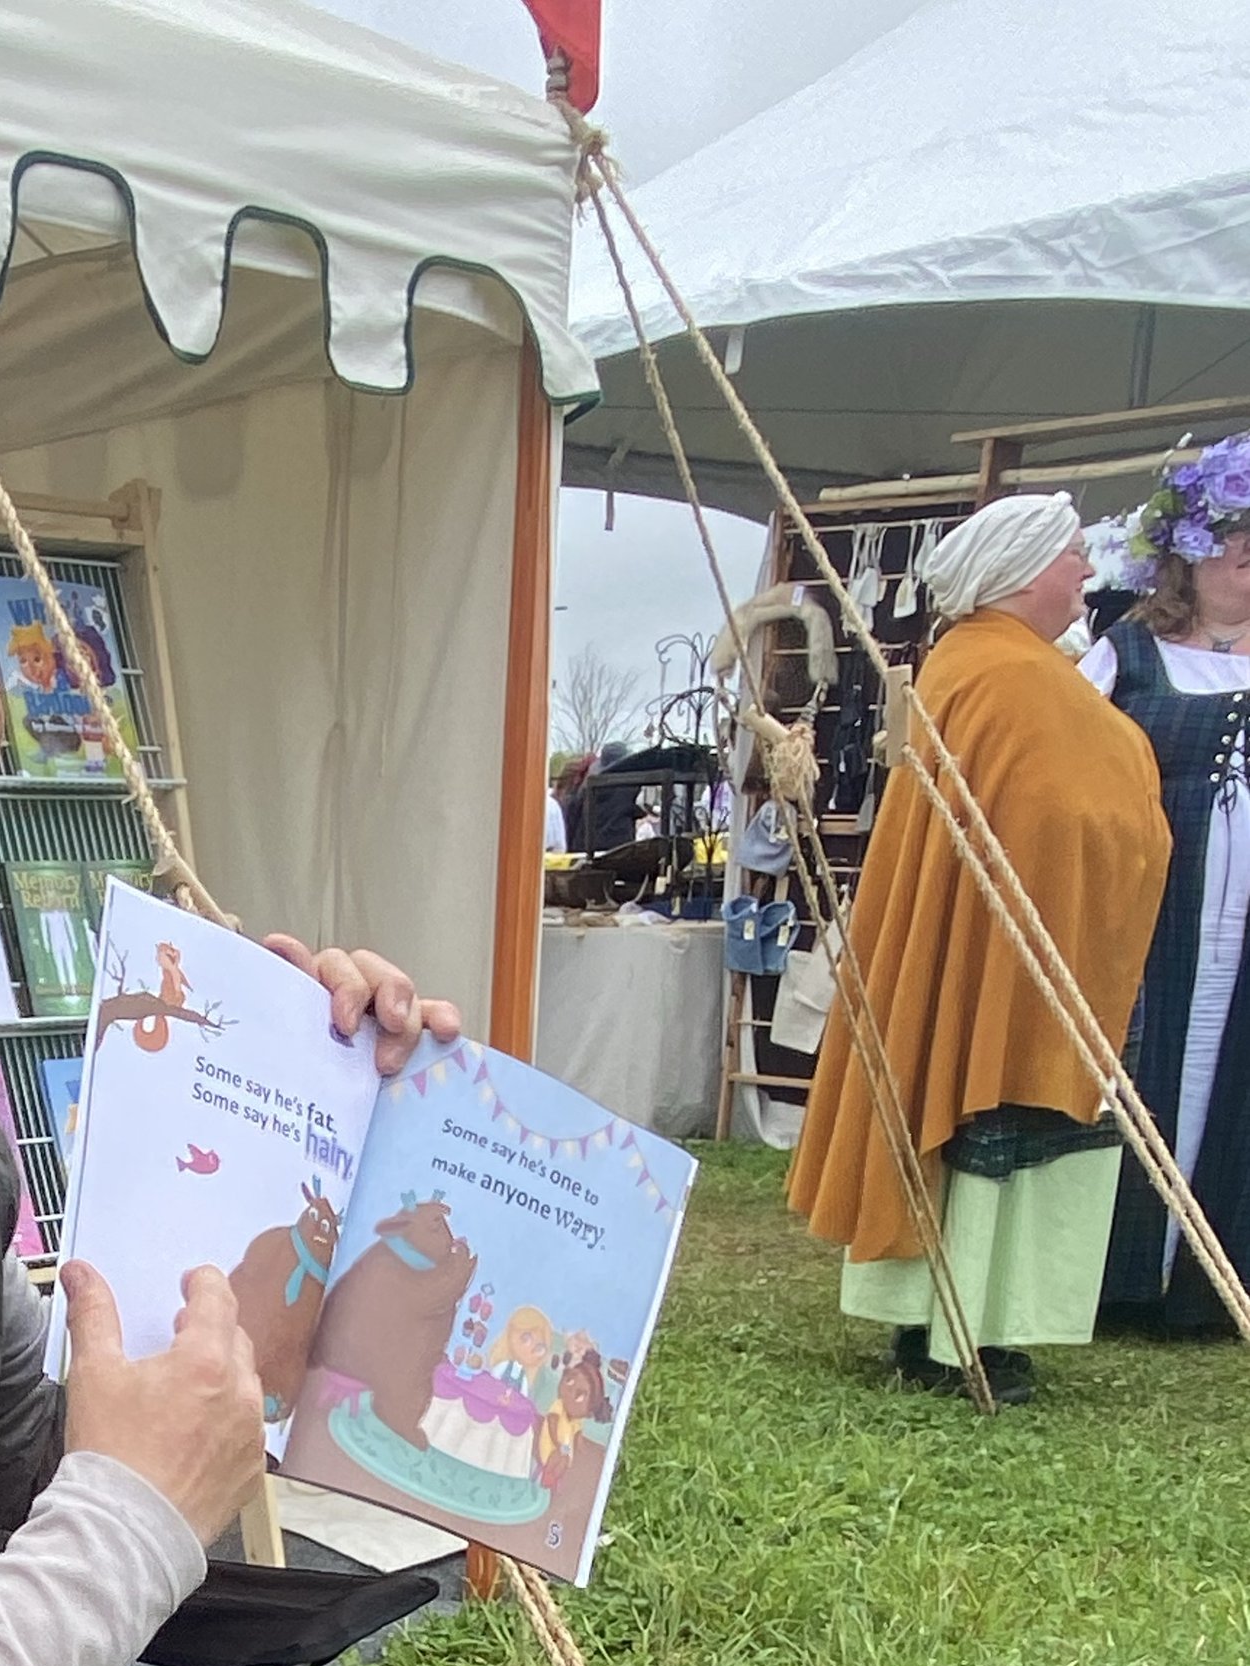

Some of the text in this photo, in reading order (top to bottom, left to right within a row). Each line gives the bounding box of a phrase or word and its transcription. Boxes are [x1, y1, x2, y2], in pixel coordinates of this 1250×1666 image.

[192, 1082, 239, 1115] Some
[243, 1106, 269, 1130] say
[272, 1114, 301, 1143] he's
[195, 1055, 242, 1088] Some
[246, 1080, 271, 1104] say
[275, 1088, 303, 1117] he's
[431, 1156, 477, 1184] make
[480, 1173, 551, 1220] anyone
[442, 1118, 599, 1206] Some say he's one to
[548, 1522, 560, 1546] 5
